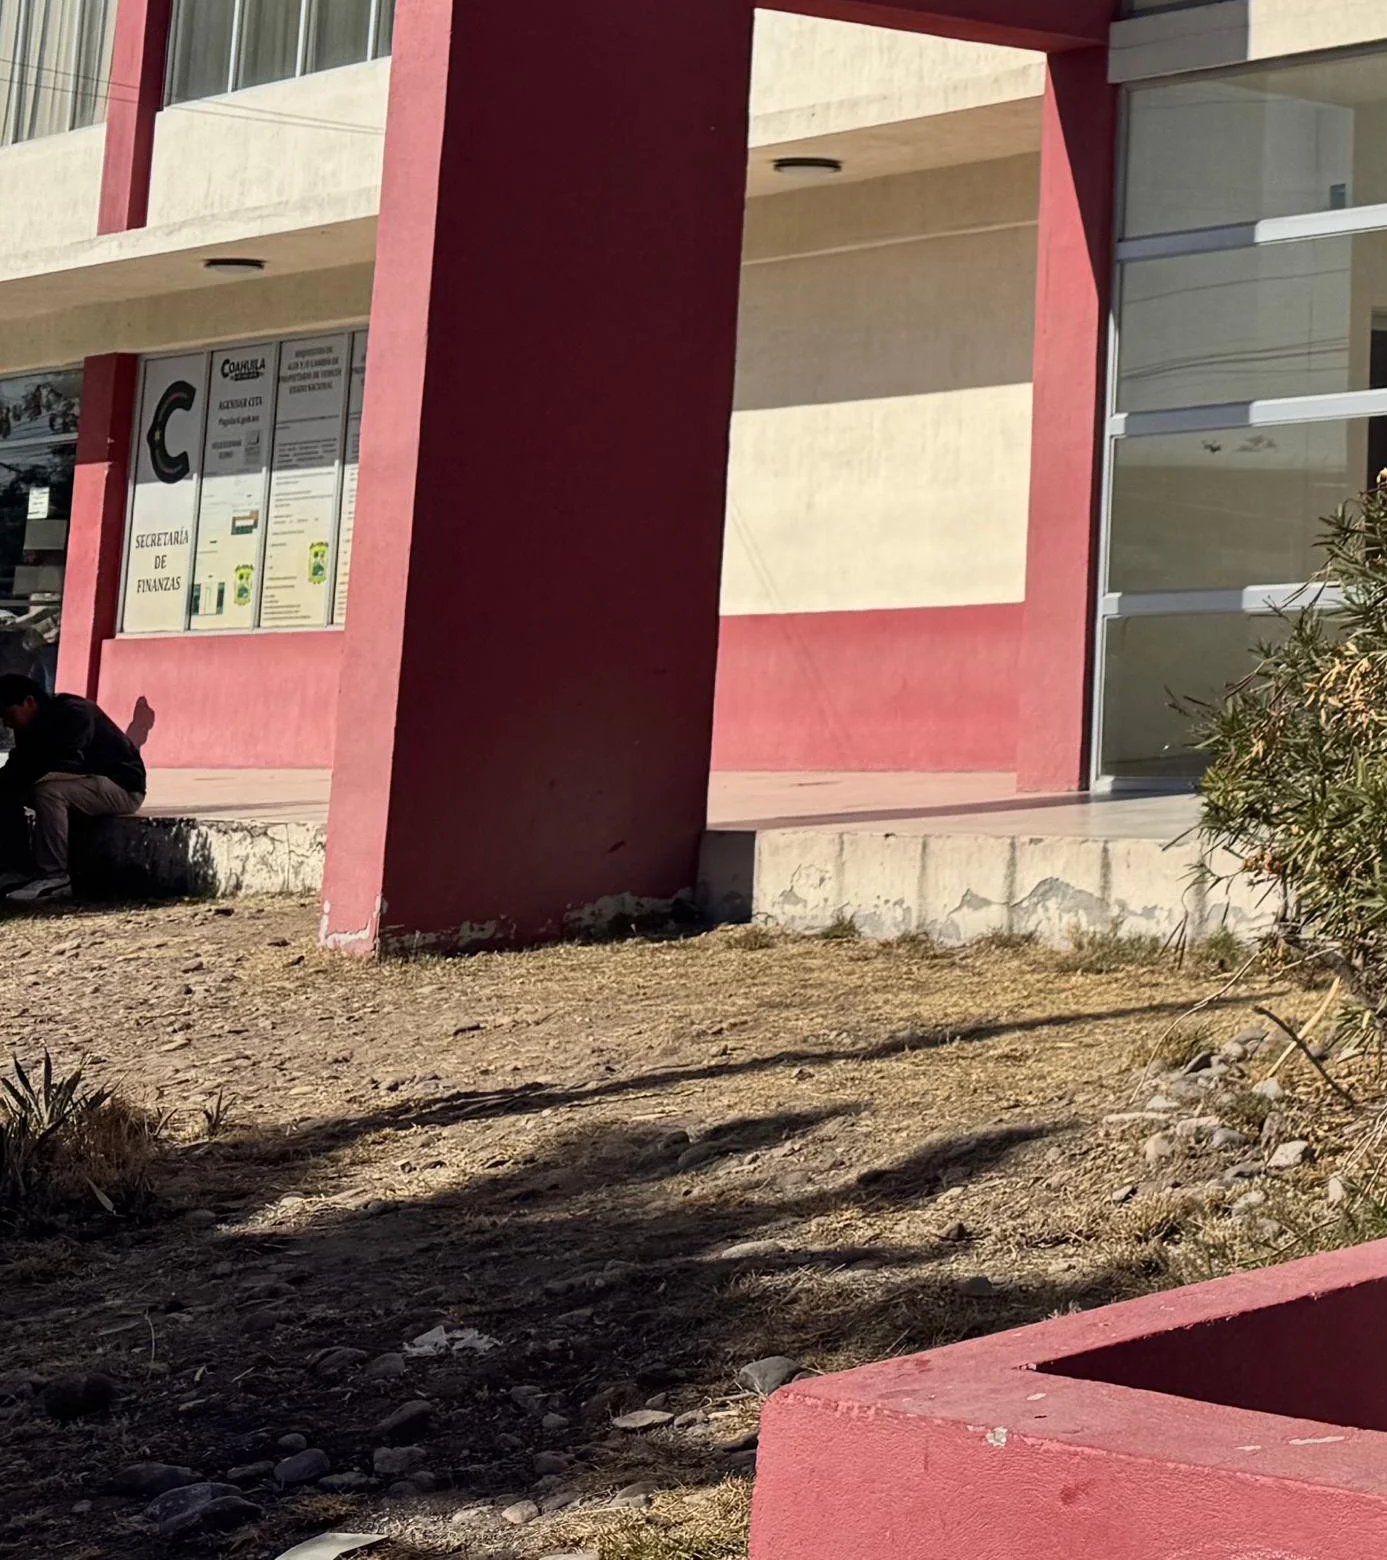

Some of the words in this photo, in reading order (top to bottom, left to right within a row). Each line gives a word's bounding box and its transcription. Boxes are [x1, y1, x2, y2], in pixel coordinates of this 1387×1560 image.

[135, 526, 189, 549] SECRETARÍA
[154, 554, 168, 570] DE
[137, 575, 181, 593] FINANZAS
